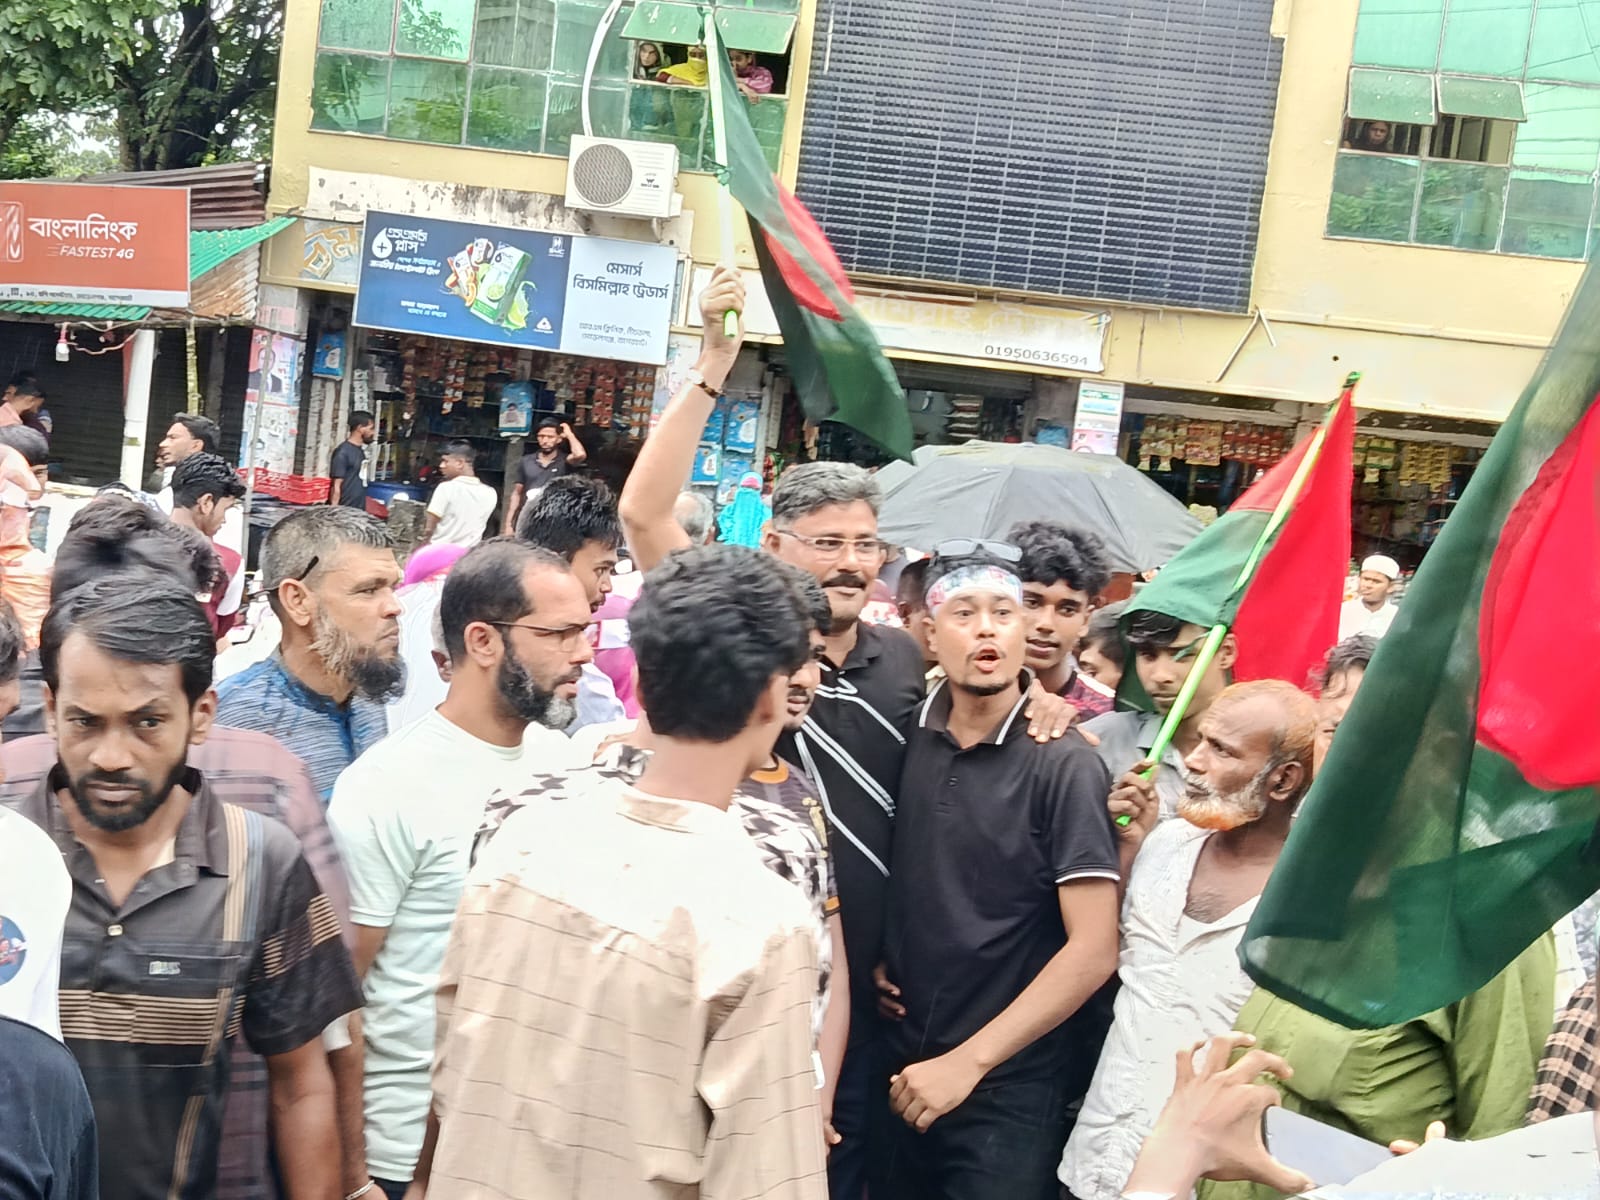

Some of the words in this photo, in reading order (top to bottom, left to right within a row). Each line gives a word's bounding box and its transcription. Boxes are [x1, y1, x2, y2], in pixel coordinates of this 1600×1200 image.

[27, 213, 138, 243] বাংলালিংক
[59, 245, 116, 258] FASTEST
[116, 248, 135, 259] 4G
[606, 261, 643, 276] মেসার্স
[573, 273, 631, 296] বিসমিল্লাহ
[633, 281, 670, 299] ট্রেডার্স
[984, 344, 1088, 366] 01950636594
